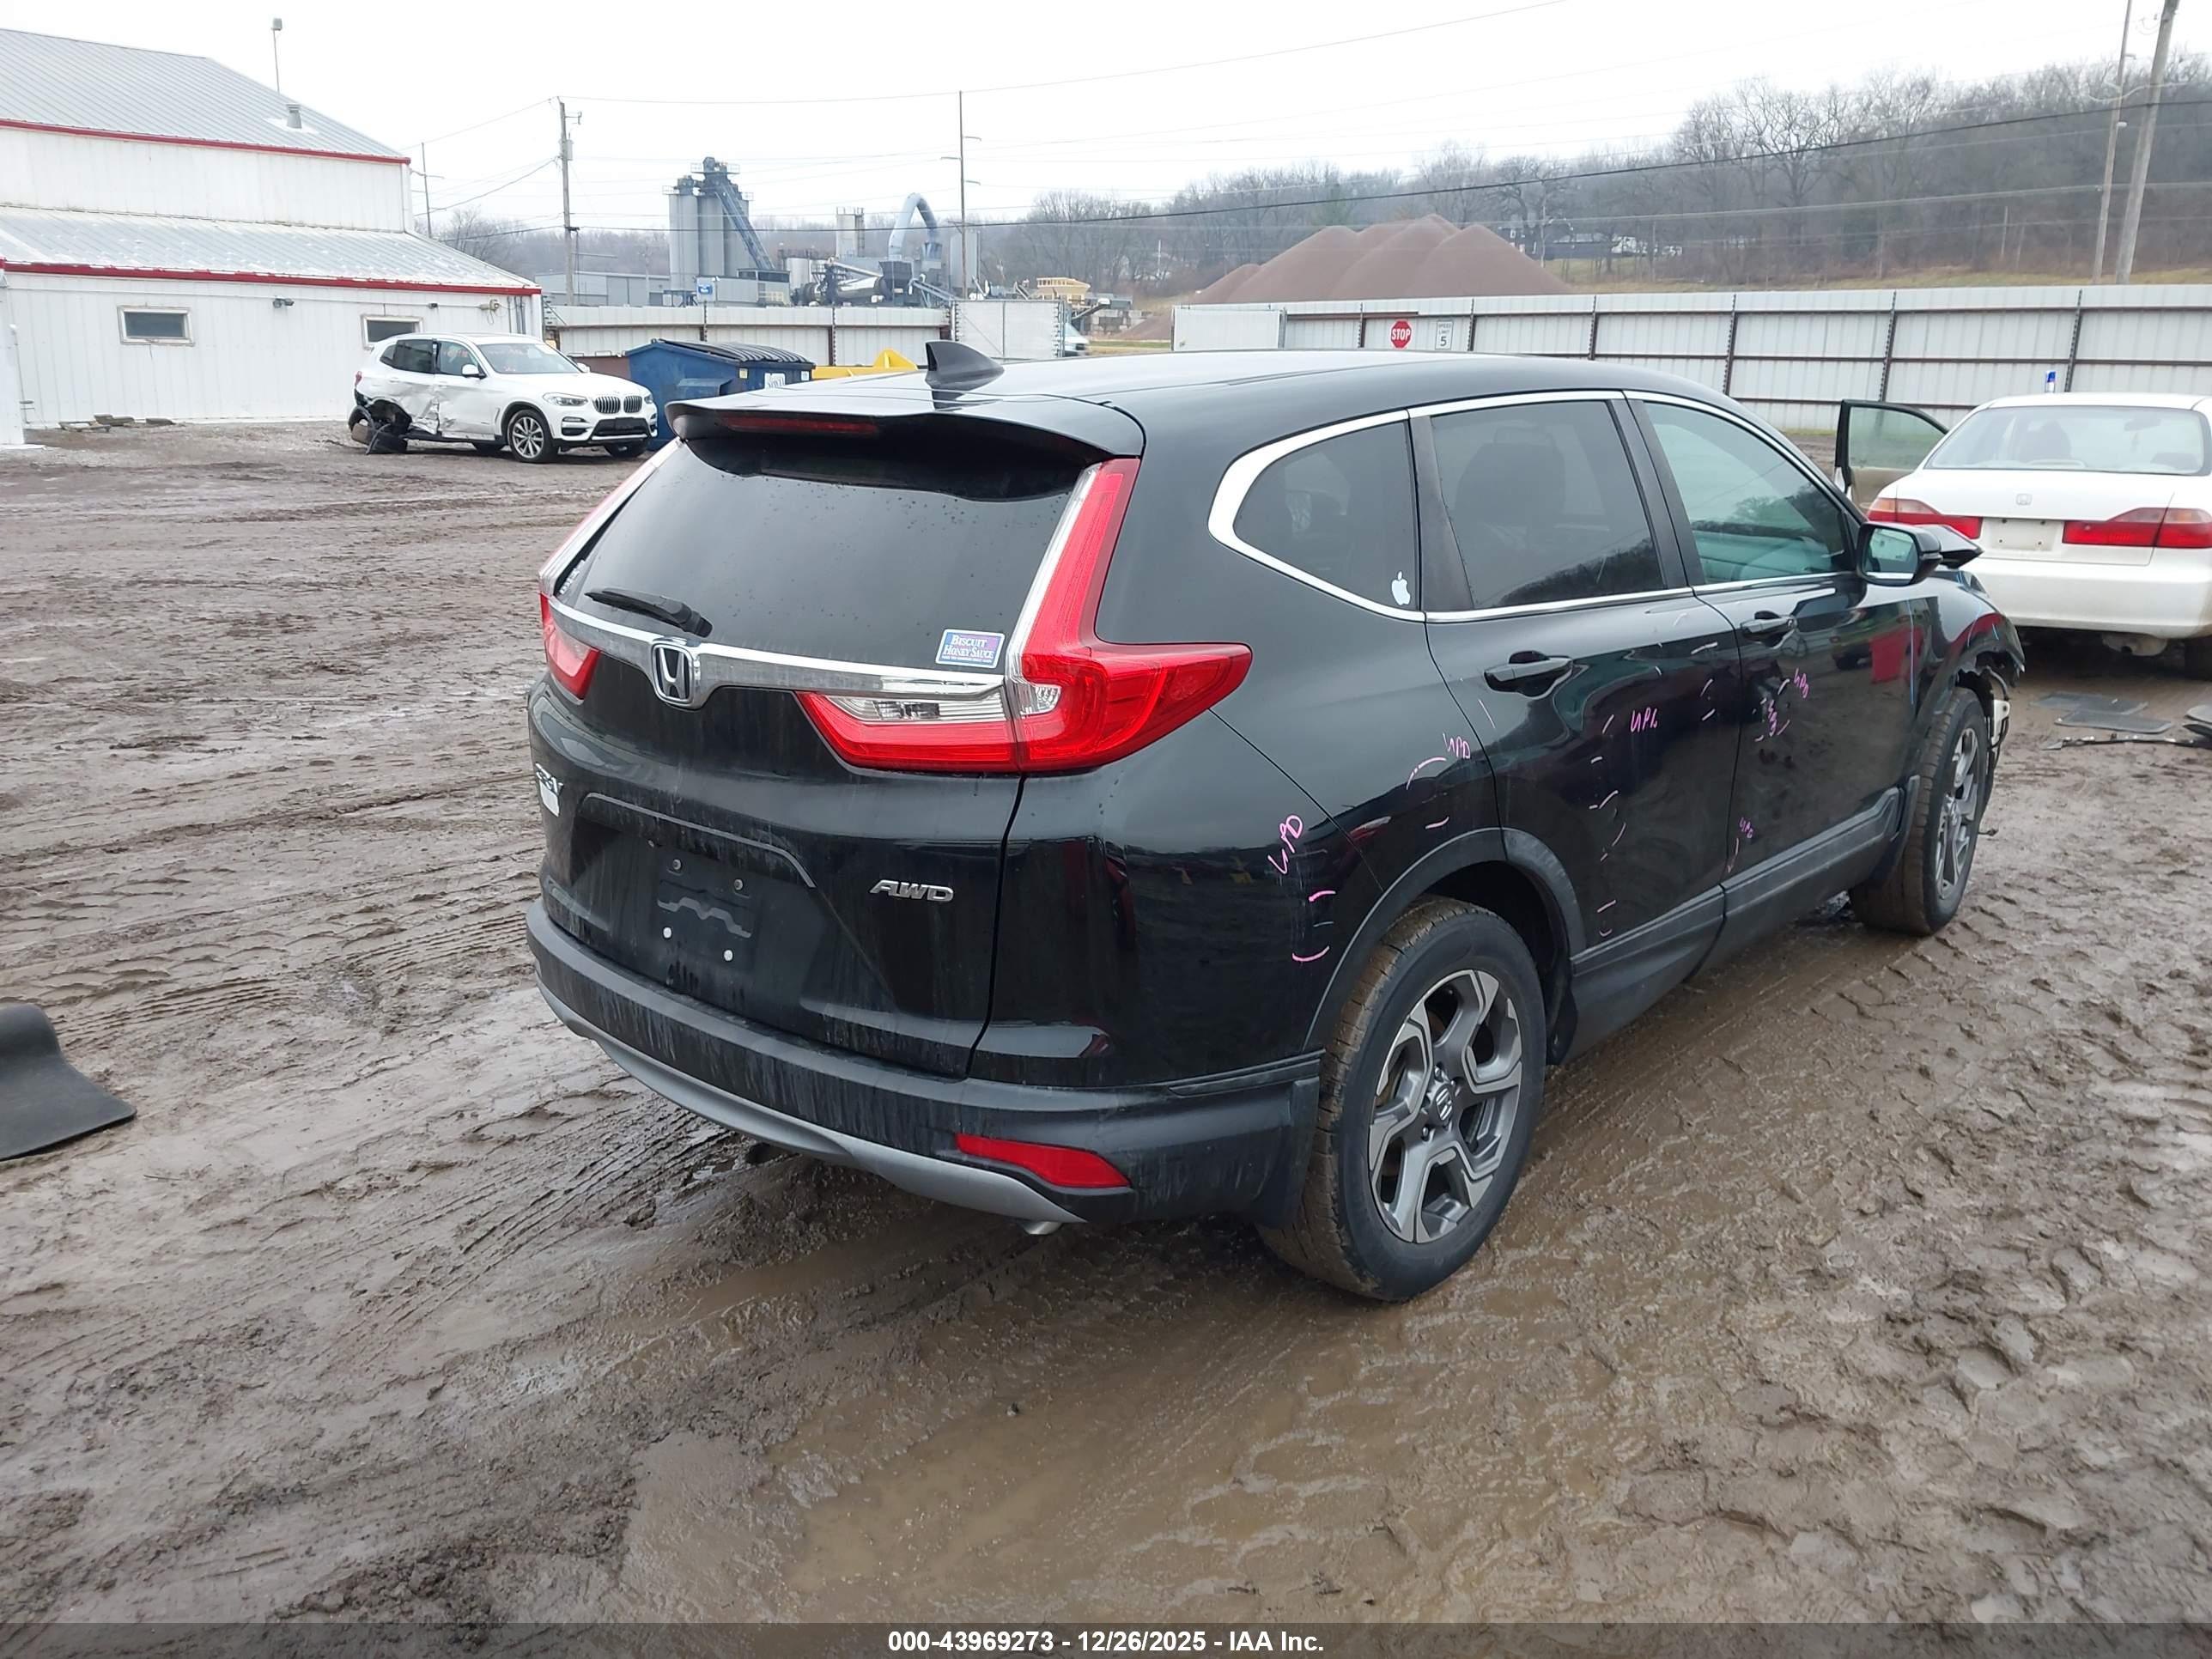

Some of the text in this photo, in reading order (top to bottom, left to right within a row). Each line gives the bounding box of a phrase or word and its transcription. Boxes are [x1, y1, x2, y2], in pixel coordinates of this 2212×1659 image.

[1391, 328, 1411, 341] STOP
[1439, 336, 1447, 347] 5
[950, 634, 988, 647] BISCUIT
[943, 645, 995, 659] HONEY SAUCE
[869, 879, 954, 902] AWD
